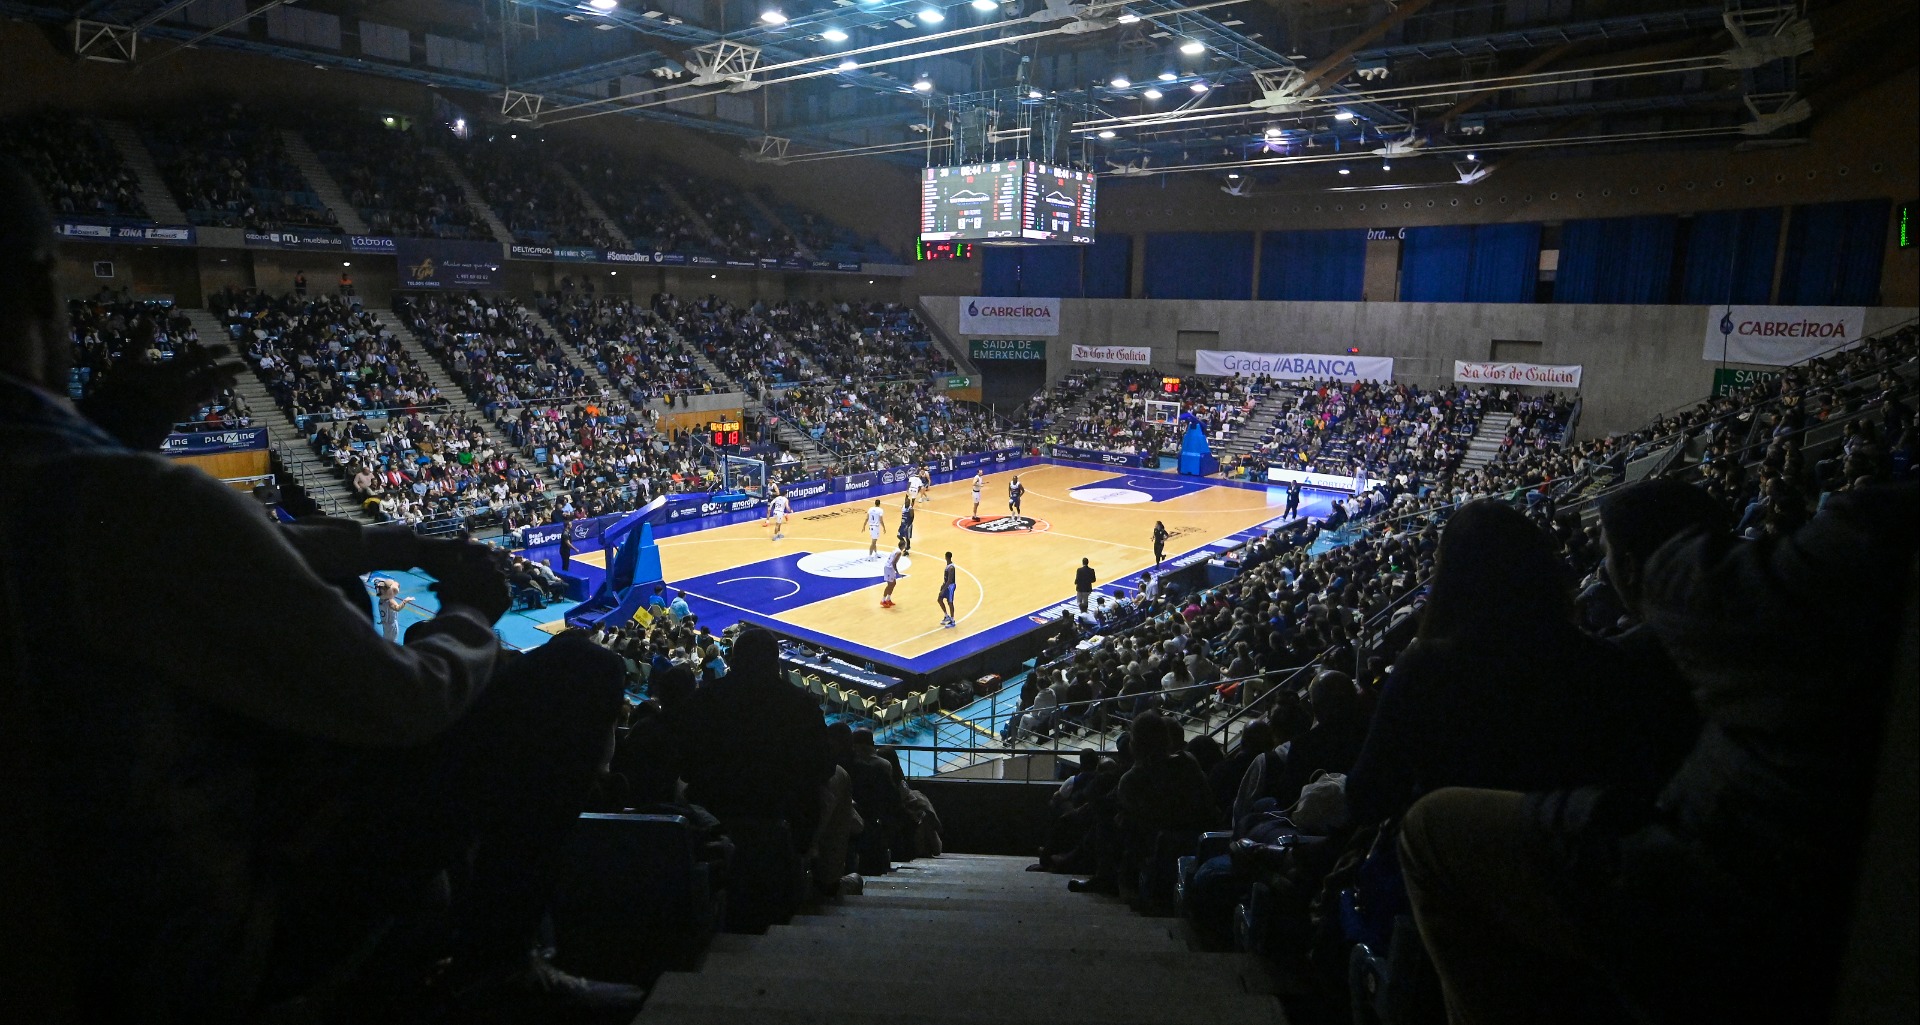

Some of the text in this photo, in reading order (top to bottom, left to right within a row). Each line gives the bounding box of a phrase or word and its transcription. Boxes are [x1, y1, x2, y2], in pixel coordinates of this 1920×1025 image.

[118, 228, 143, 237] ZONA
[987, 230, 1013, 238] BYD
[303, 237, 330, 245] muebles
[607, 251, 650, 262] #SomosObra
[981, 305, 1051, 318] CABREIROÁ
[1738, 319, 1846, 338] CABREIROÁ
[982, 340, 1032, 349] SAIDA DE
[973, 350, 1041, 359] EMERXENCIA
[1089, 346, 1105, 360] Voz
[1106, 348, 1115, 360] de
[1116, 348, 1146, 361] Galicia
[1223, 355, 1271, 372] Grada
[1460, 363, 1573, 383] La Voz de Galicia
[728, 431, 738, 445] 18
[1102, 454, 1128, 463] BYD
[786, 482, 826, 498] indupanel
[845, 480, 870, 491] MONBUS
[1103, 612, 1113, 623] 12
